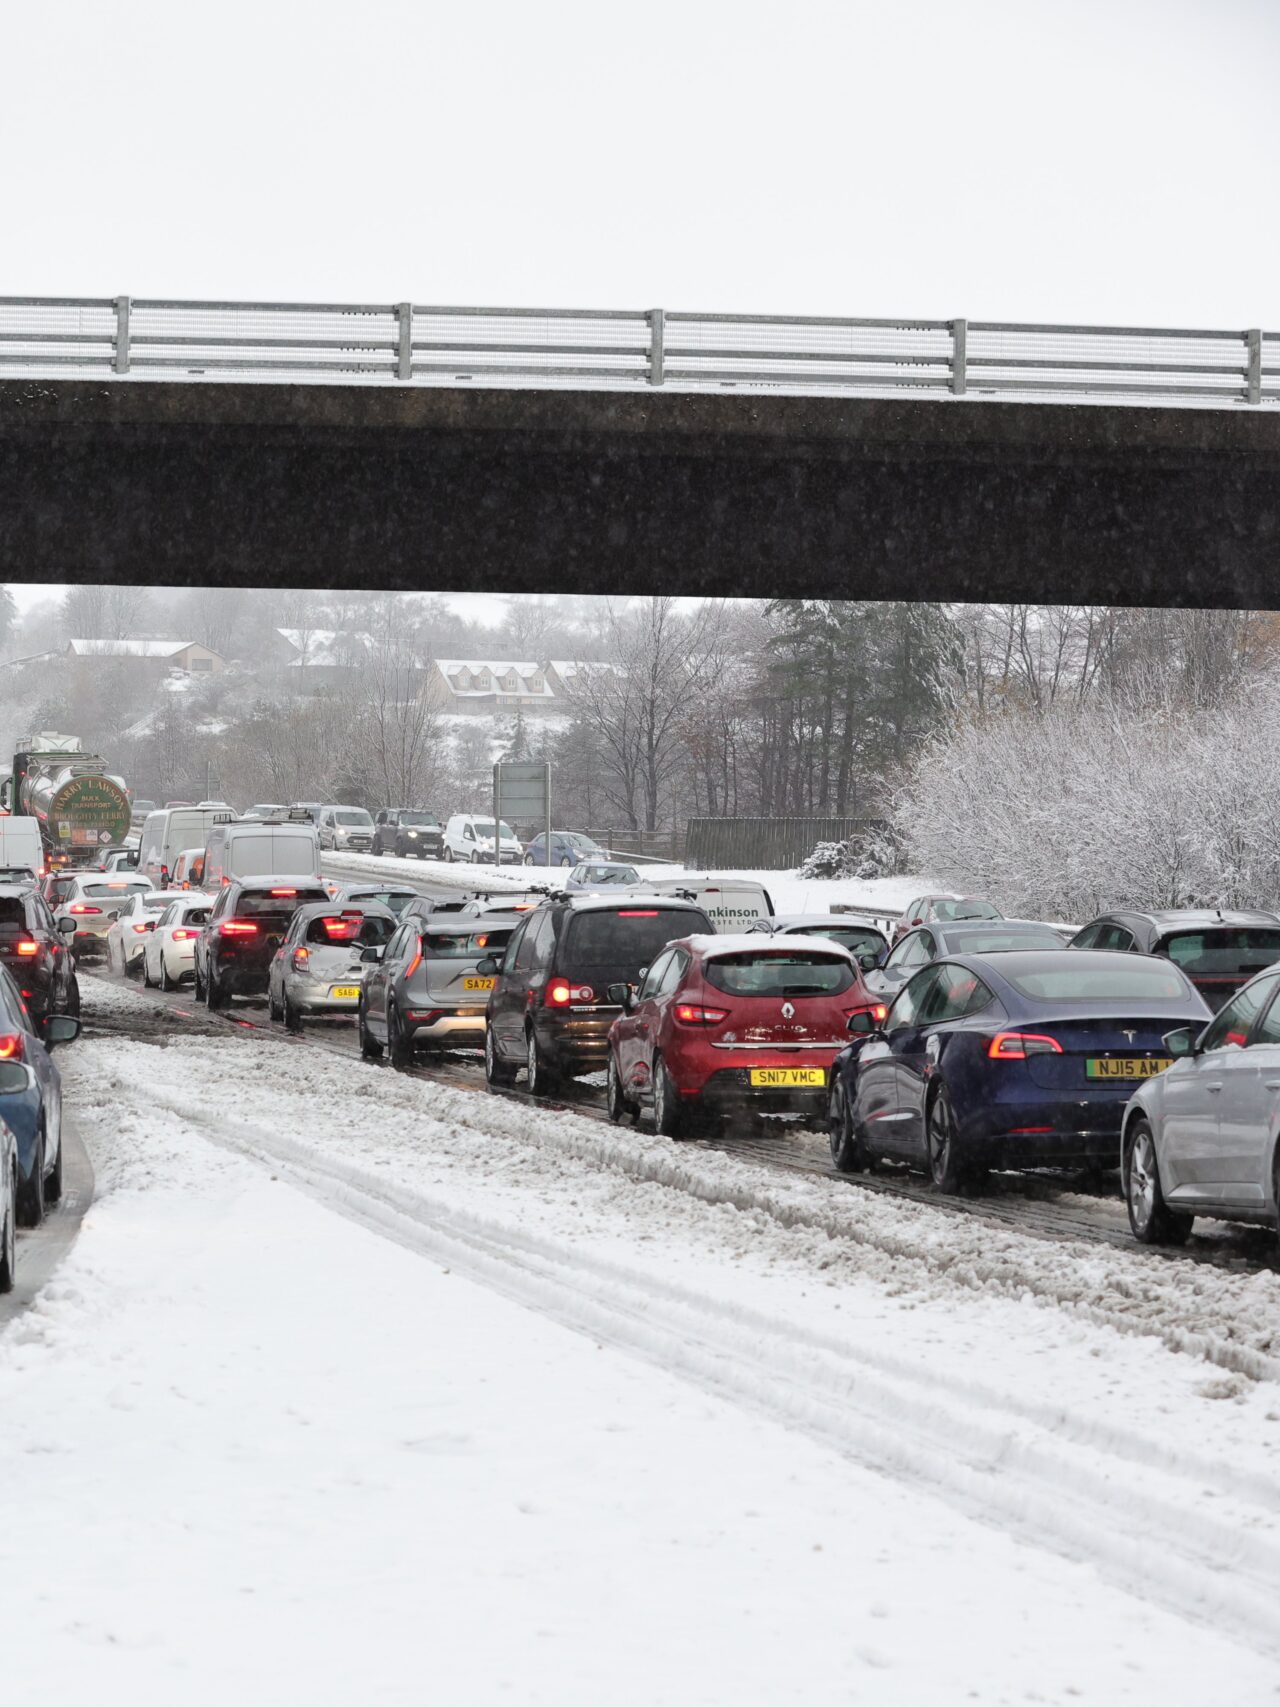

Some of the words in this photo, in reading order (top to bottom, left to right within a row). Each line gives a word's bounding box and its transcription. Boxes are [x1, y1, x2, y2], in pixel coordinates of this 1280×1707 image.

[56, 781, 82, 810] HARRY
[88, 780, 124, 810] LAWSON
[706, 907, 759, 917] nkinson
[467, 979, 492, 989] SA72
[338, 988, 355, 997] SA61
[1099, 1061, 1134, 1075] NJ15
[760, 1071, 786, 1083] SN17
[792, 1071, 816, 1083] VMC
